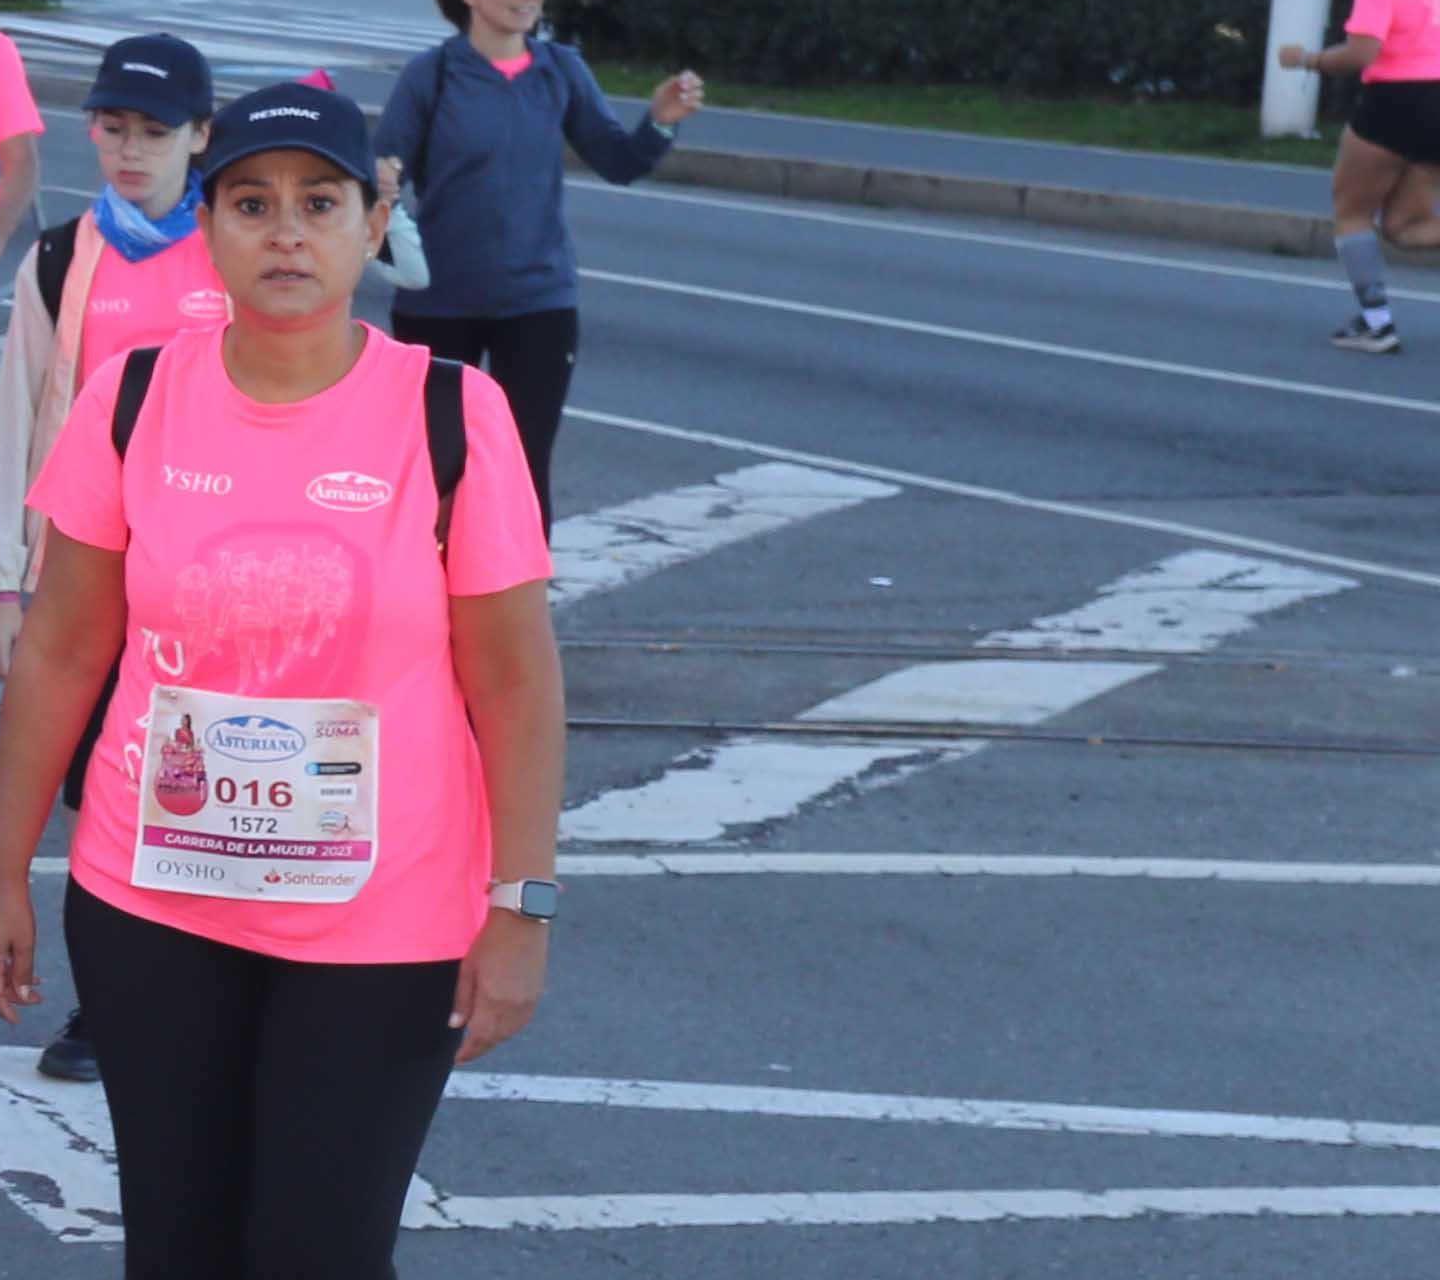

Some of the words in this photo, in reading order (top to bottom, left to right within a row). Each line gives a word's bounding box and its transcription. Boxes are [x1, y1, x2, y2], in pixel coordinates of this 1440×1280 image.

[248, 106, 321, 122] RESONAC
[163, 464, 233, 496] YSHO
[313, 482, 387, 503] ASTURIANA
[140, 626, 186, 677] TU
[212, 729, 298, 753] ASTURIANA
[315, 725, 361, 738] SUMA
[214, 777, 294, 809] 016
[228, 816, 279, 835] 1572
[163, 831, 225, 852] CARRERA
[226, 841, 247, 855] DE
[247, 843, 267, 856] LA
[268, 842, 317, 857] MUJER
[320, 845, 353, 857] 2023
[155, 858, 226, 882] OYSHO
[282, 871, 356, 888] Santander
